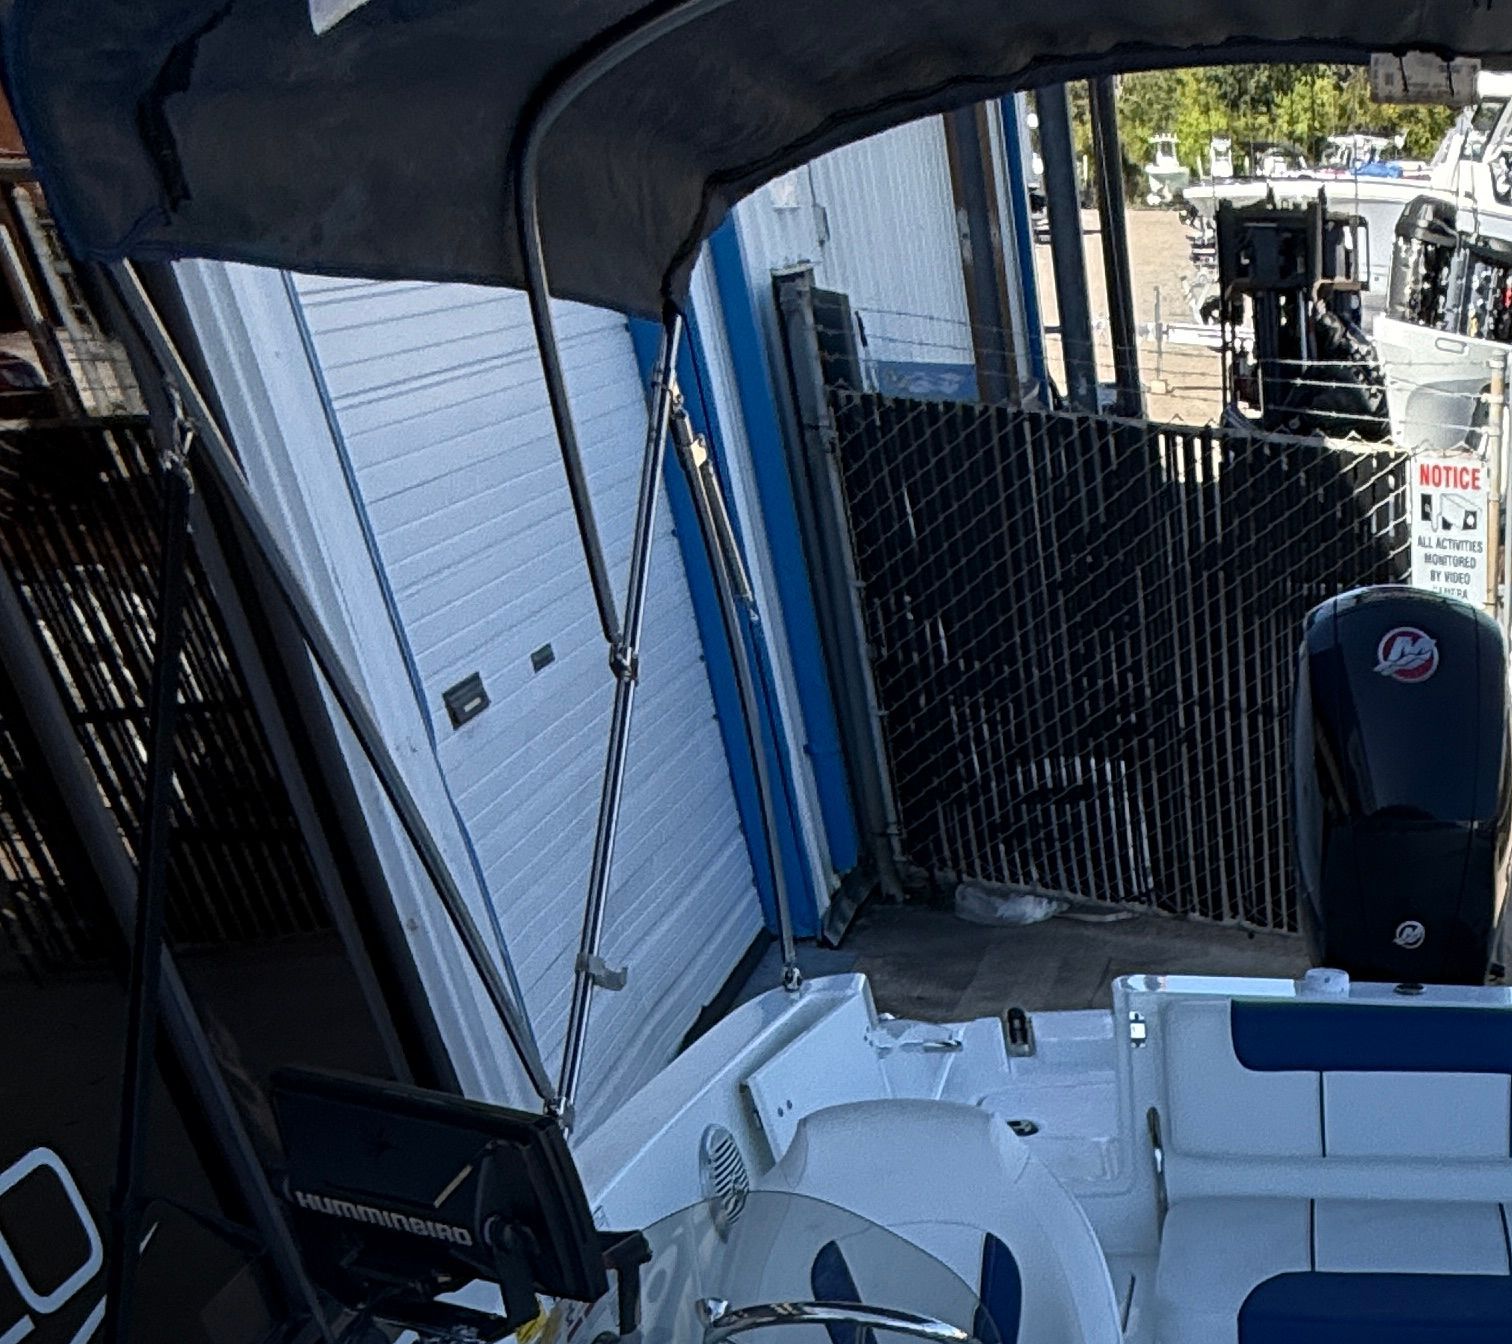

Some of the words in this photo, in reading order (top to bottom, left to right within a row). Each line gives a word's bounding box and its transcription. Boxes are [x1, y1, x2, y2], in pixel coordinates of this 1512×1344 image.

[1420, 463, 1481, 490] NOTICE
[1417, 535, 1433, 548] ALL
[1436, 537, 1483, 553] ACTIVITIES
[1424, 553, 1476, 569] MONITORED
[1430, 569, 1441, 581] BY
[1444, 571, 1471, 585] VIDEO
[295, 1190, 473, 1247] HUMMINBIRD
